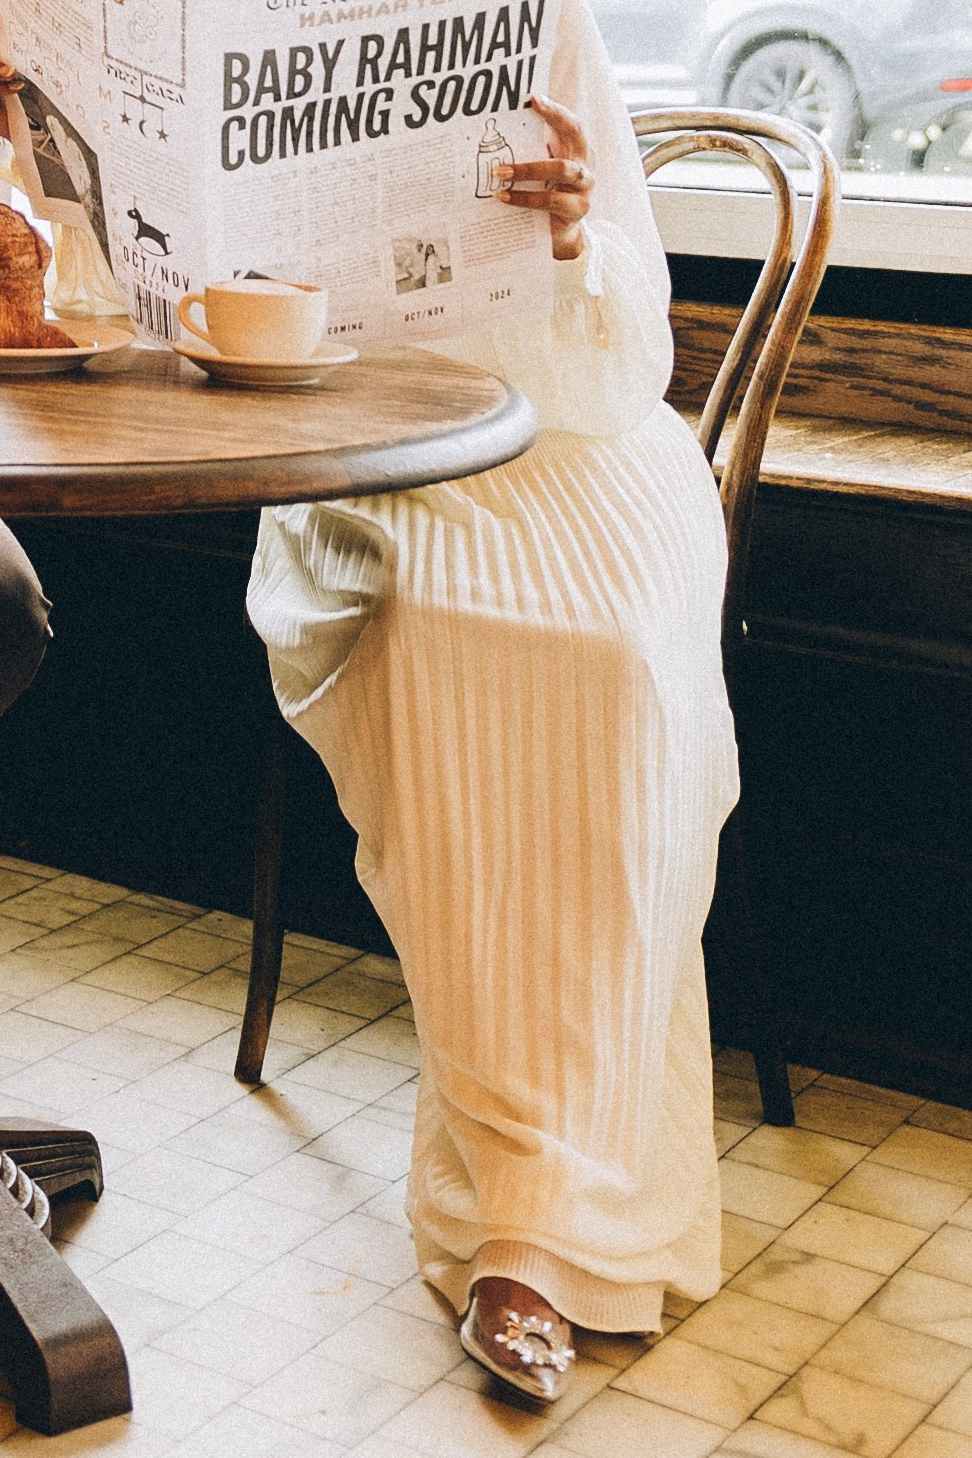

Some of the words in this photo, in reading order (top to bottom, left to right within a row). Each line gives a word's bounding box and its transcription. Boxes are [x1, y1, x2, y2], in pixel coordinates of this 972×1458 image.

[222, 38, 346, 111] BABY
[220, 87, 395, 171] COMING
[403, 54, 538, 130] SOON!
[123, 245, 191, 293] OCT/NOV
[328, 321, 364, 336] COMING
[403, 305, 446, 323] OCT/NOV
[488, 288, 512, 302] 2024
